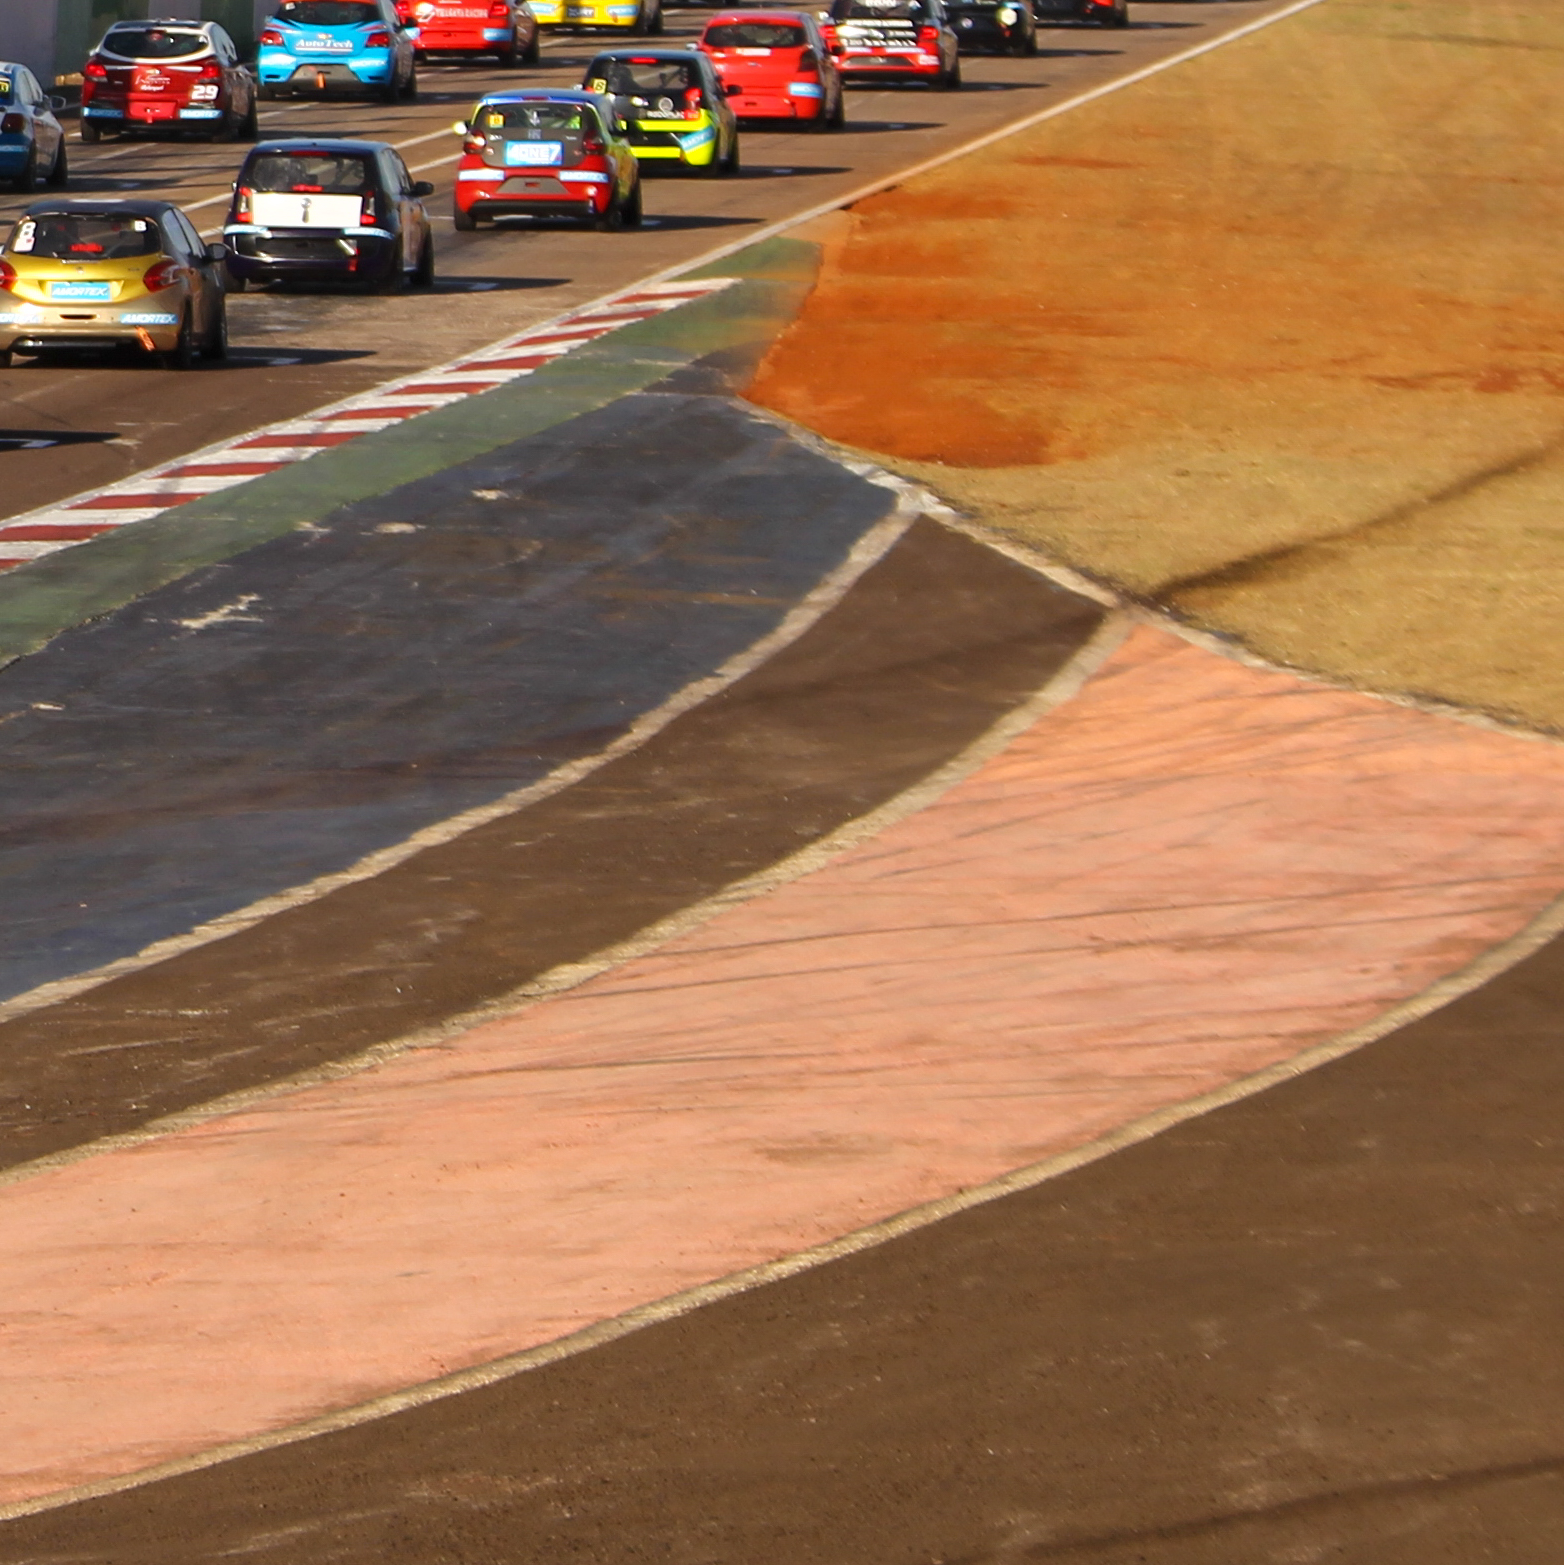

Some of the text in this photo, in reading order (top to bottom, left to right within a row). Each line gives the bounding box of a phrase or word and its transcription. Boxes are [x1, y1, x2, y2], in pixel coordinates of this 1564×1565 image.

[295, 37, 354, 49] AutoTech
[191, 84, 219, 100] 29
[51, 286, 110, 299] AMORTEX
